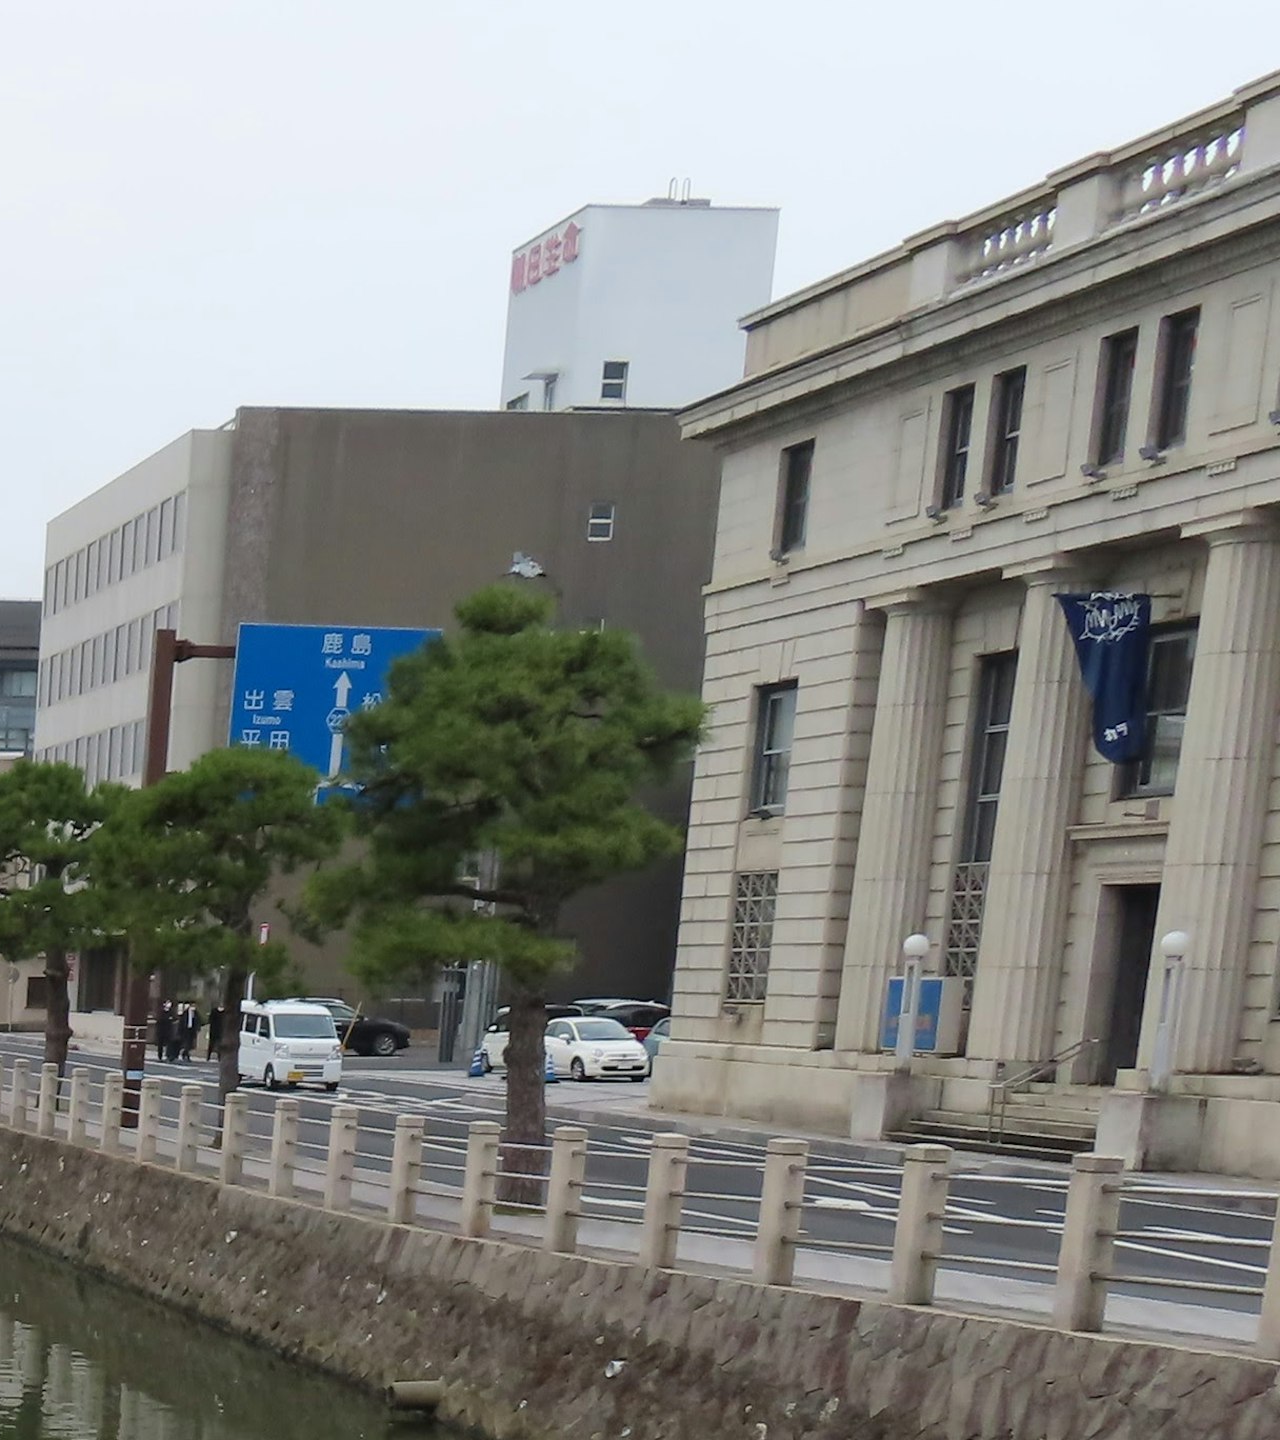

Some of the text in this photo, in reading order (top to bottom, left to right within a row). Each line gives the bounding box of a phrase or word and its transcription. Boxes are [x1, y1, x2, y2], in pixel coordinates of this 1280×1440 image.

[321, 633, 372, 655] 鹿島
[325, 658, 366, 670] Kashima
[243, 689, 295, 711] 出雲
[361, 692, 383, 711] 松
[252, 714, 282, 726] Izumo
[241, 729, 290, 750] 平田
